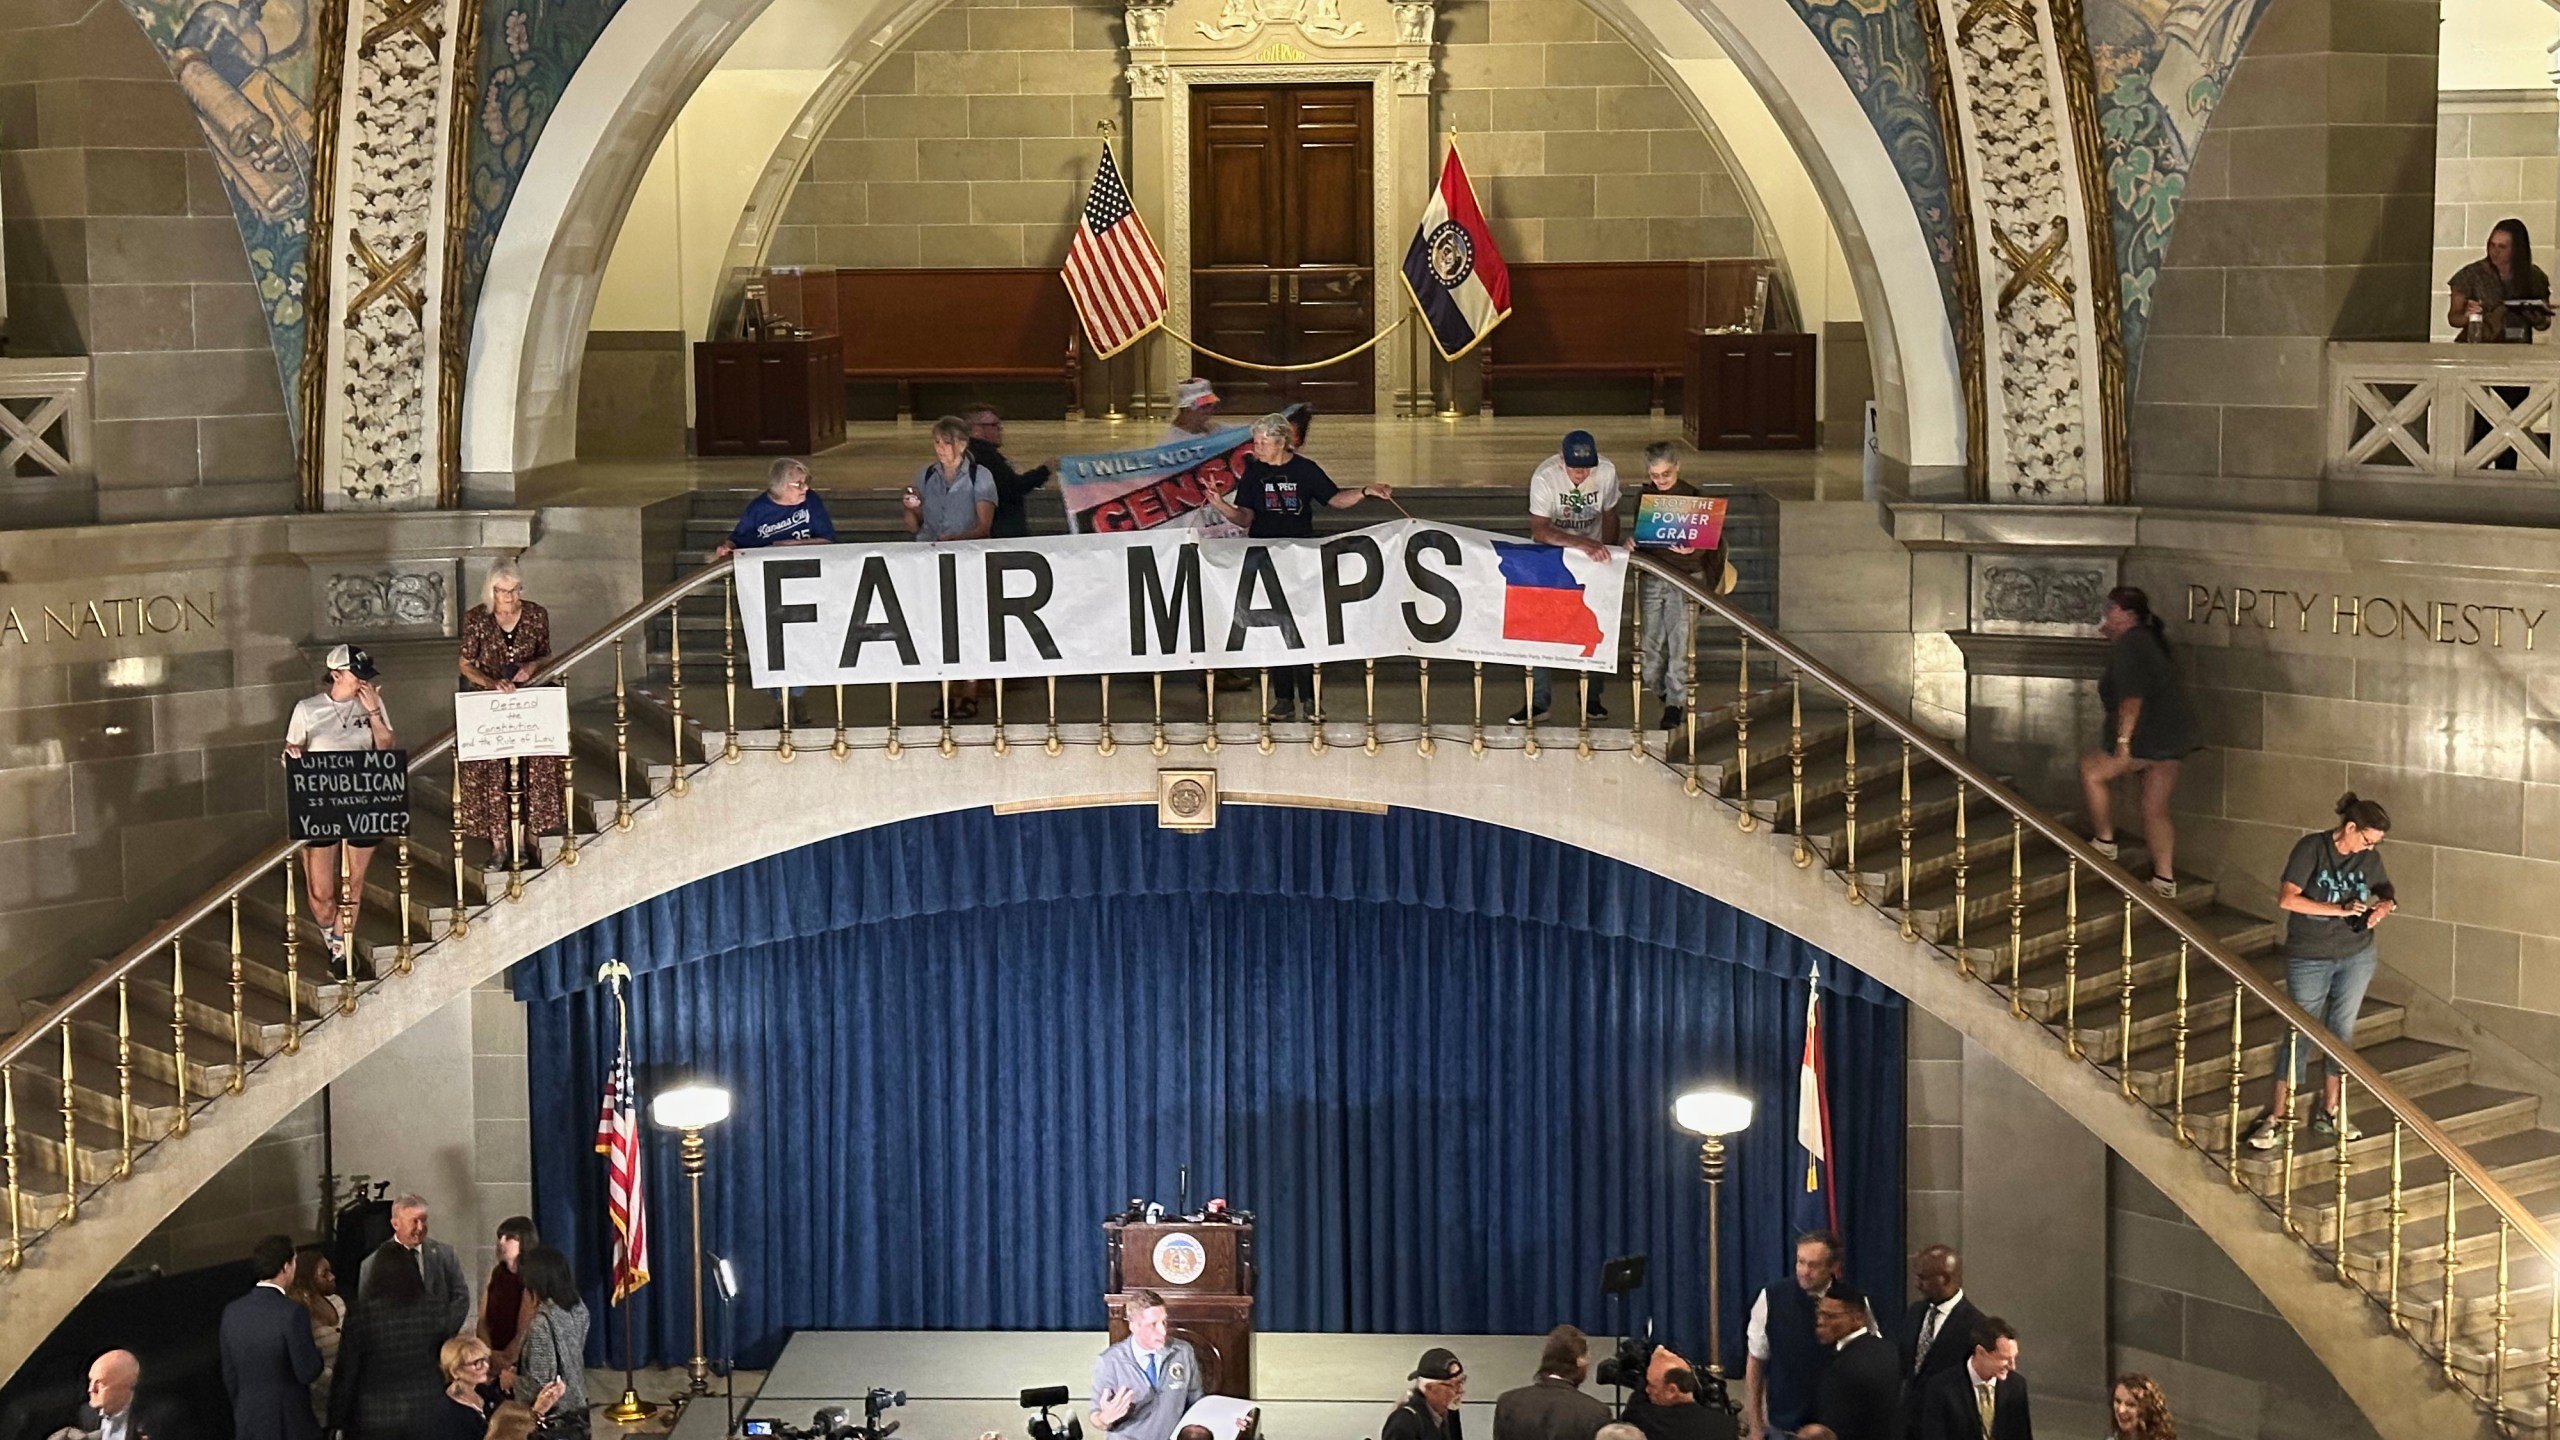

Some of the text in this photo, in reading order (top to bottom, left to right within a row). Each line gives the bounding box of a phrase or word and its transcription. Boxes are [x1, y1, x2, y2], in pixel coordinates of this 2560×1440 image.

[1255, 43, 1306, 62] GOVERNOR
[1093, 455, 1153, 477] WILL
[1157, 445, 1205, 468] NOT
[1653, 498, 1714, 510] STOP THE
[757, 508, 810, 539] Kansas City
[1651, 512, 1709, 525] POWER
[1656, 527, 1698, 540] GRAB
[763, 529, 1463, 671] FAIR MAPS
[0, 591, 216, 646] A NATION
[2188, 584, 2549, 650] PARTY HONESTY
[353, 718, 371, 729] 44
[506, 712, 522, 720] the
[462, 734, 555, 748] and the Rule of Law
[301, 751, 396, 769] WHICH MO
[293, 772, 405, 792] REPUBLICAN
[308, 794, 403, 807] IS TAKING AWAY
[347, 812, 410, 835] VOICE?
